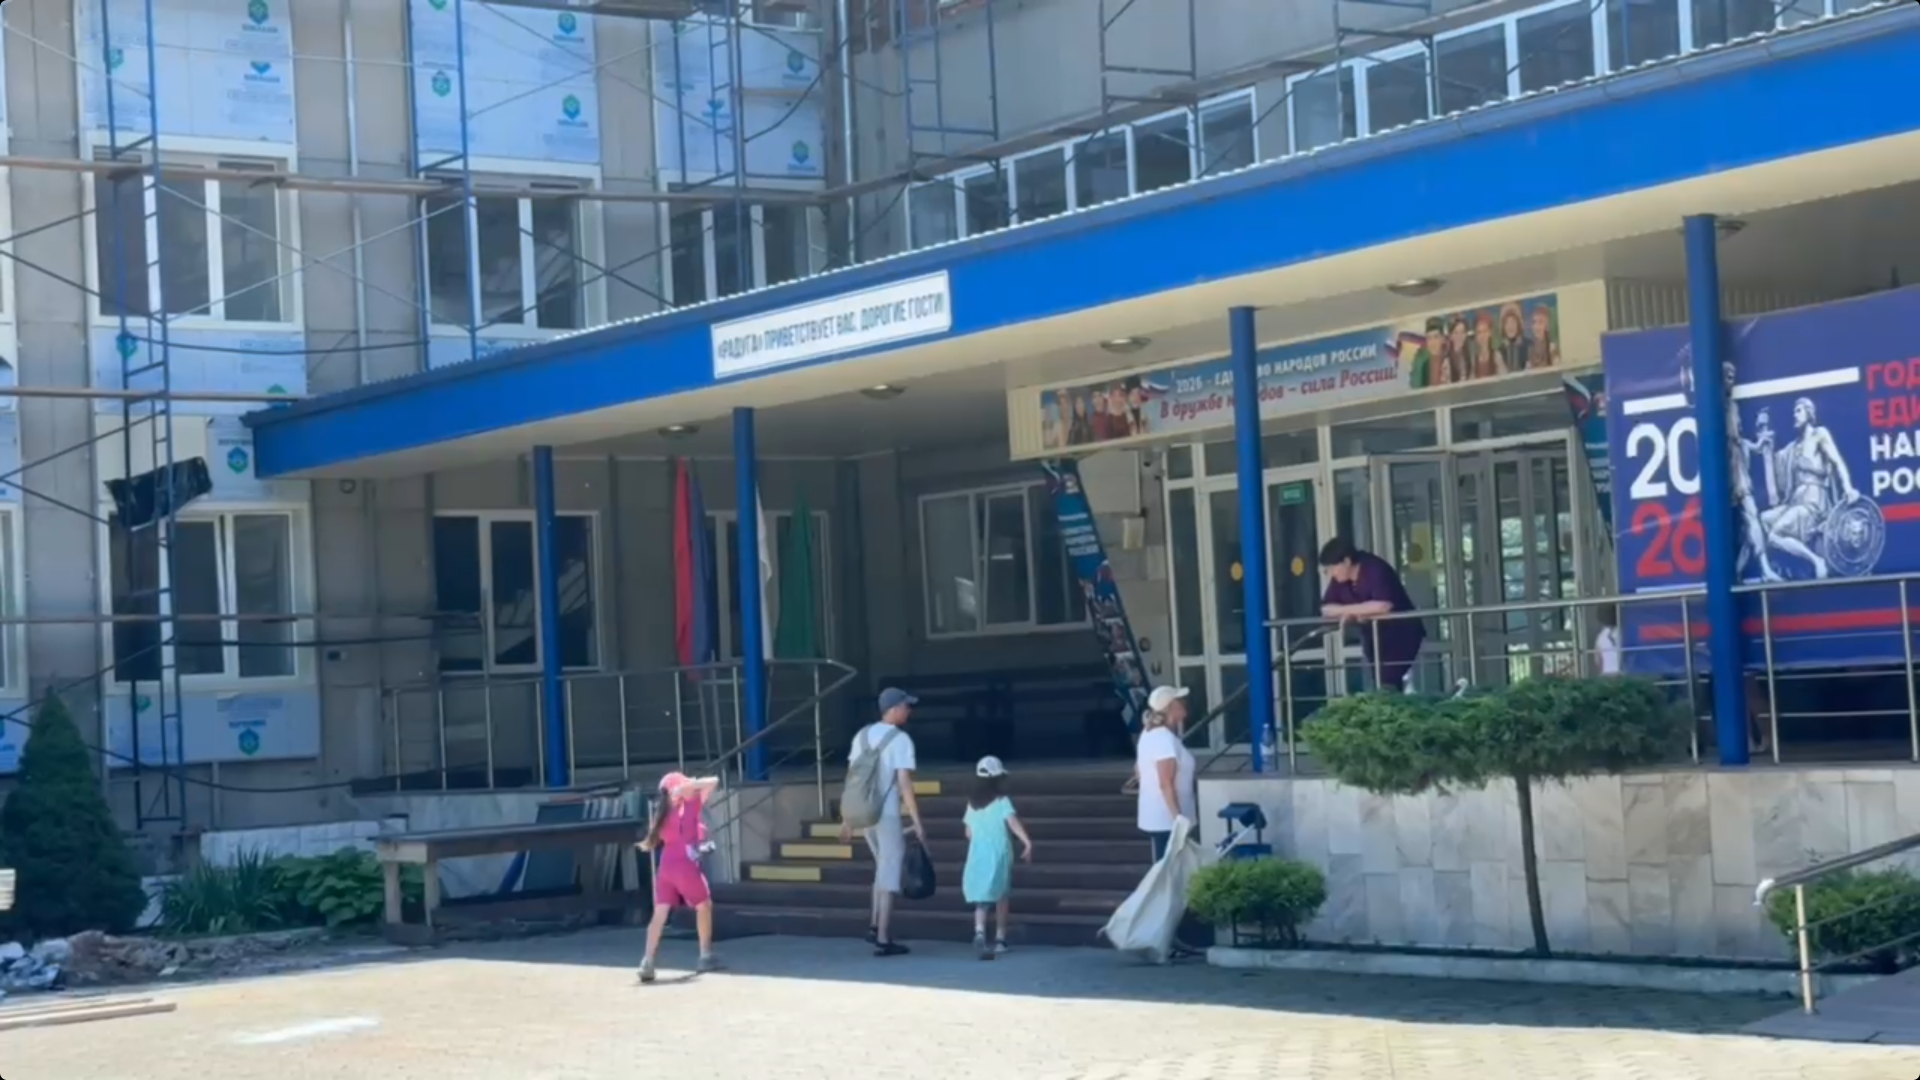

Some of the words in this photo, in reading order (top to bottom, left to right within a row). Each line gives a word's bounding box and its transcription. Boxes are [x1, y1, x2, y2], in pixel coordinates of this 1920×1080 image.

[764, 316, 835, 351] ПРИВЕТСТВУЕТ
[861, 299, 907, 333] ДОРОГИЕ
[1160, 400, 1169, 419] В
[1172, 393, 1223, 422] дружбе
[1301, 376, 1335, 395] сила
[1339, 361, 1399, 389] России!
[1176, 375, 1203, 394] 2026
[1274, 353, 1327, 374] НАРОДОВ
[1331, 343, 1377, 364] РОССИИ
[1626, 416, 1701, 500] 20
[1631, 497, 1706, 578] 26
